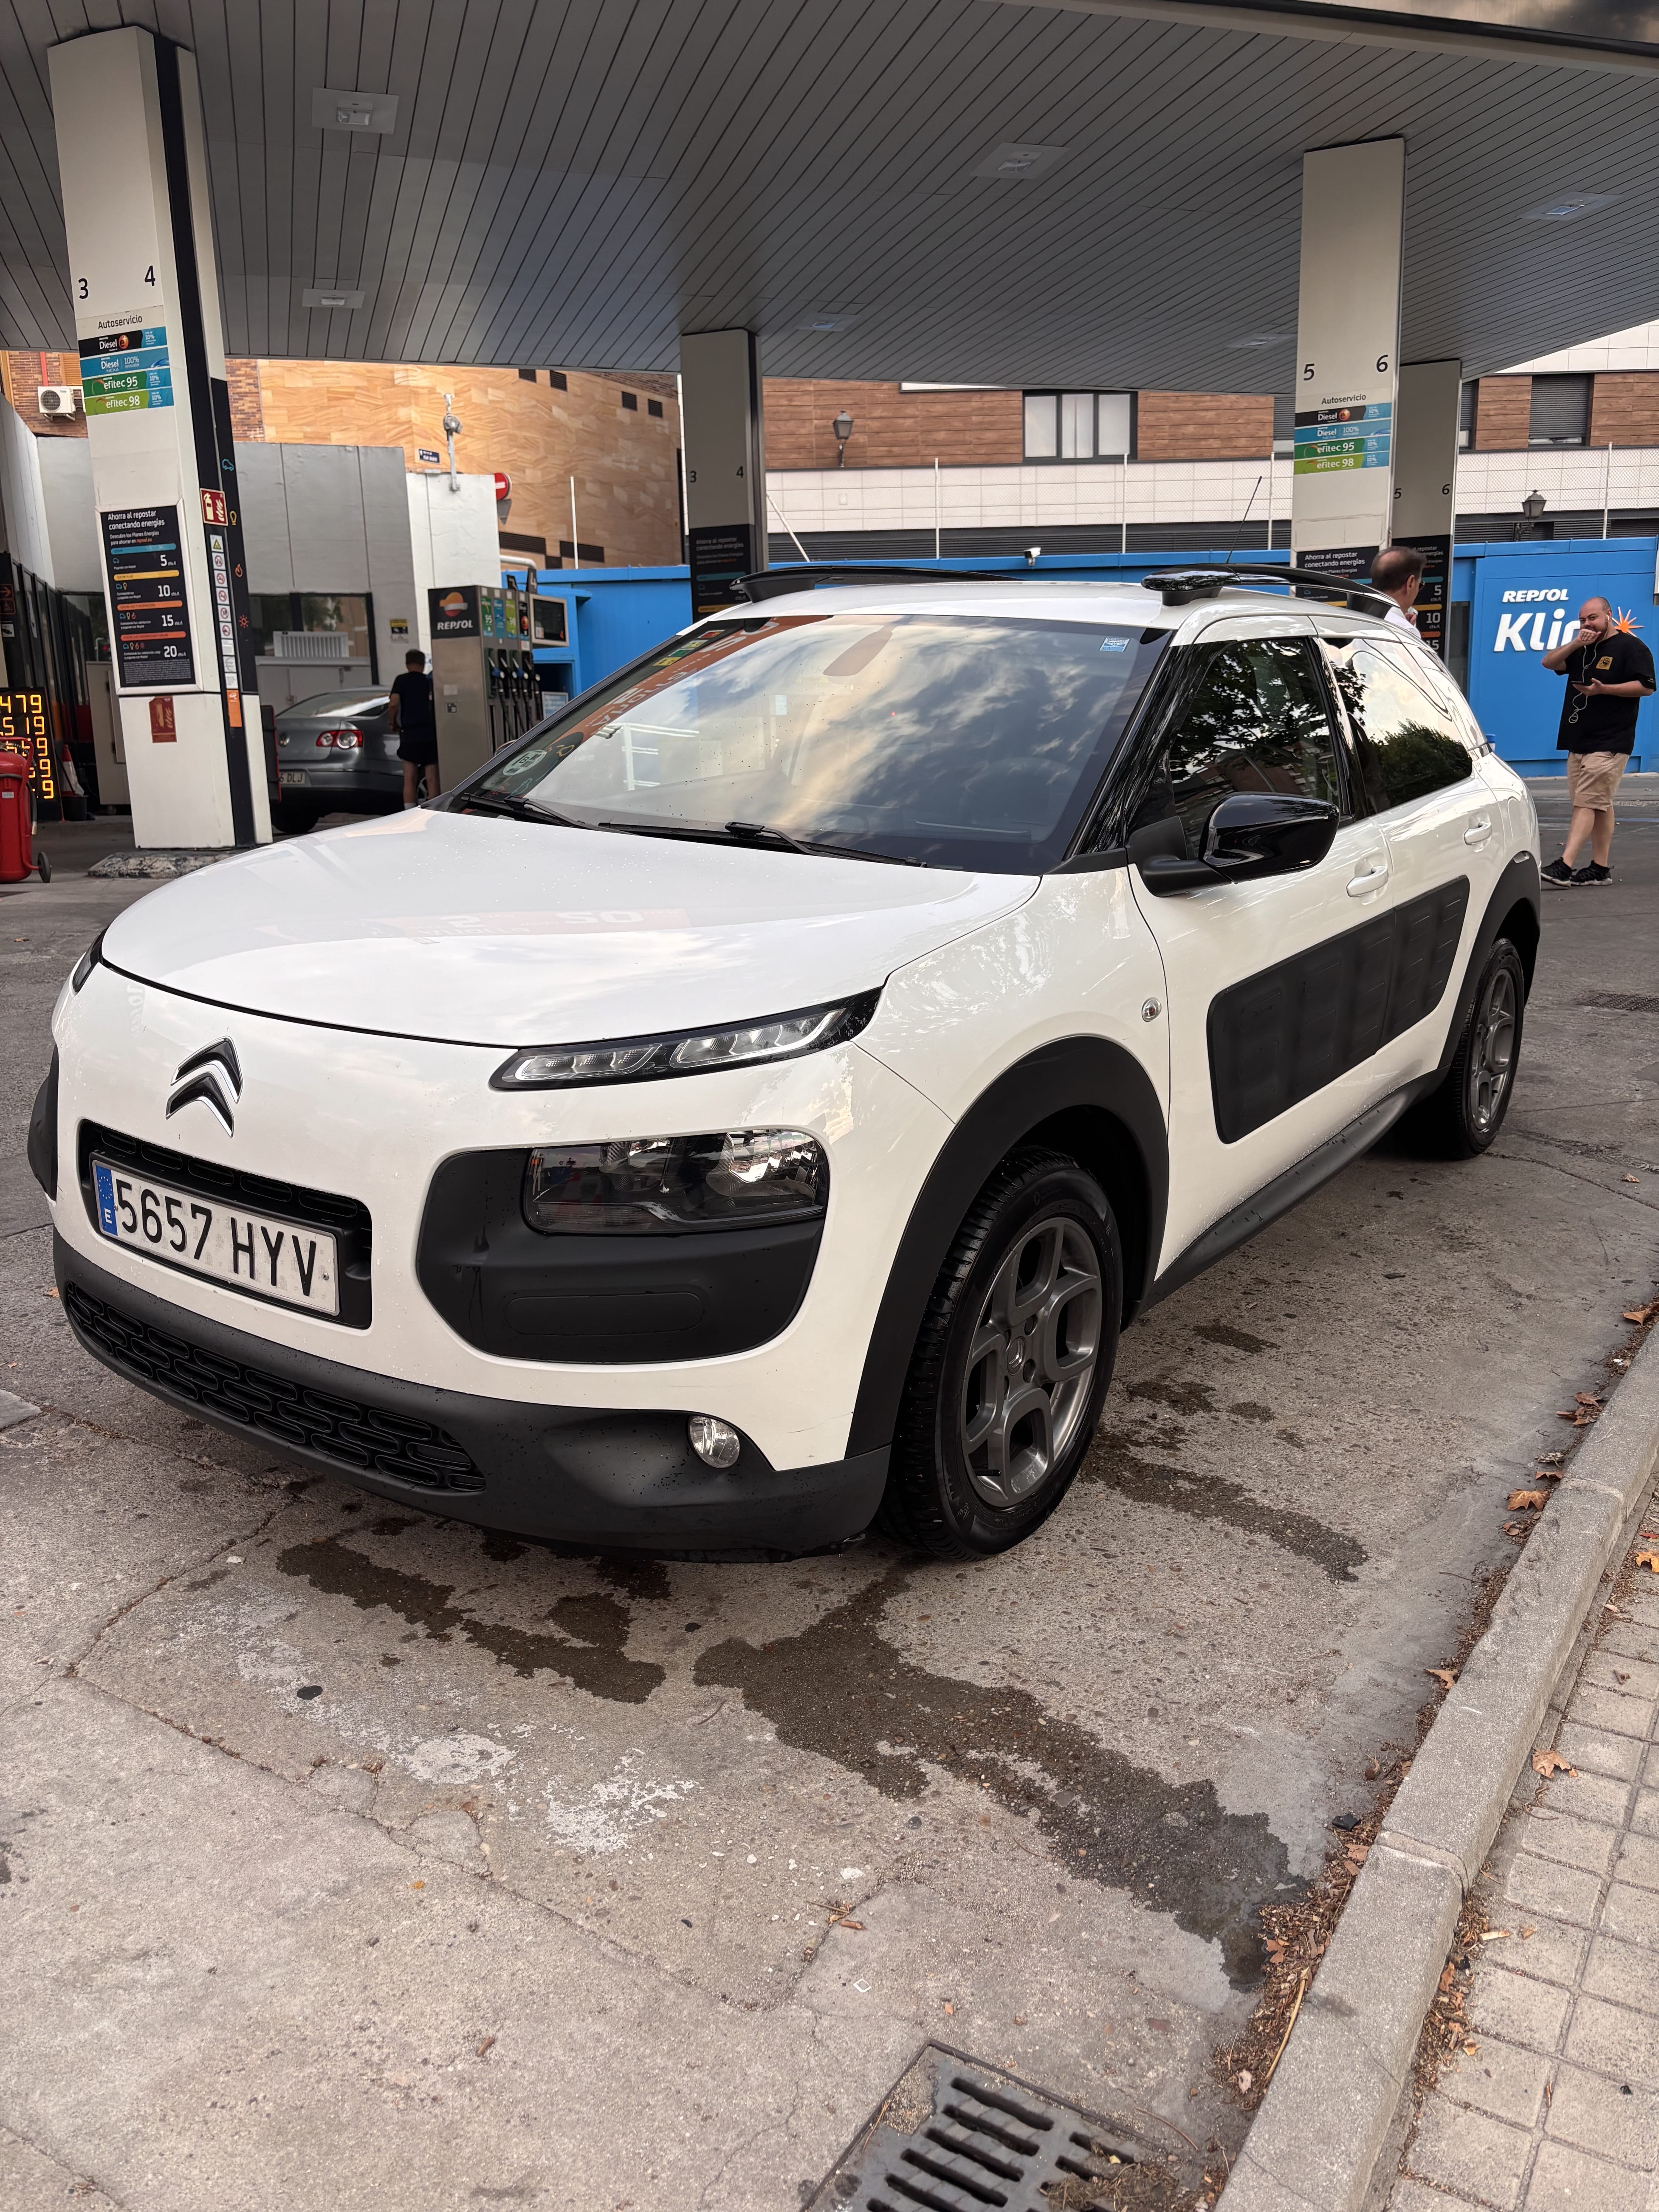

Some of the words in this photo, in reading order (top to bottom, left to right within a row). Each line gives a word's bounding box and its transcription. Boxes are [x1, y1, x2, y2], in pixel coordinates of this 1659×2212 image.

[144, 266, 155, 286] 4
[78, 278, 89, 299] 3
[98, 314, 143, 329] Autoservicio
[99, 339, 117, 349] Diesel
[101, 359, 119, 369] Diesel
[124, 356, 139, 364] 100%
[1376, 354, 1388, 372] 6
[1303, 363, 1315, 381] 5
[104, 380, 126, 390] efitec
[126, 376, 138, 387] 95
[106, 398, 128, 409] efitec
[129, 395, 140, 405] 98
[1321, 394, 1367, 405] Autoservicio
[1317, 412, 1338, 421] Diesel
[1317, 429, 1336, 437] Diesel
[1317, 444, 1341, 453] efitec
[1342, 442, 1355, 452] 95
[1317, 460, 1341, 469] efitec
[1342, 458, 1354, 467] 98
[690, 471, 697, 483] 3
[736, 466, 744, 478] 4
[1394, 488, 1402, 499] 5
[1442, 484, 1451, 495] 6
[133, 510, 156, 520] repostar
[109, 520, 140, 530] conectando
[141, 518, 165, 528] energías
[160, 555, 168, 567] 5
[1340, 558, 1365, 566] energías
[158, 585, 170, 597] 10
[1434, 585, 1442, 596] 5
[1502, 589, 1569, 603] REPSOL
[161, 615, 173, 627] 15
[1426, 612, 1441, 624] 10
[437, 620, 473, 630] REPSOL
[163, 646, 177, 658] 20
[287, 773, 304, 783] DLJ
[105, 1207, 113, 1224] E
[116, 1178, 212, 1261] 5657
[231, 1217, 317, 1297] HYV
